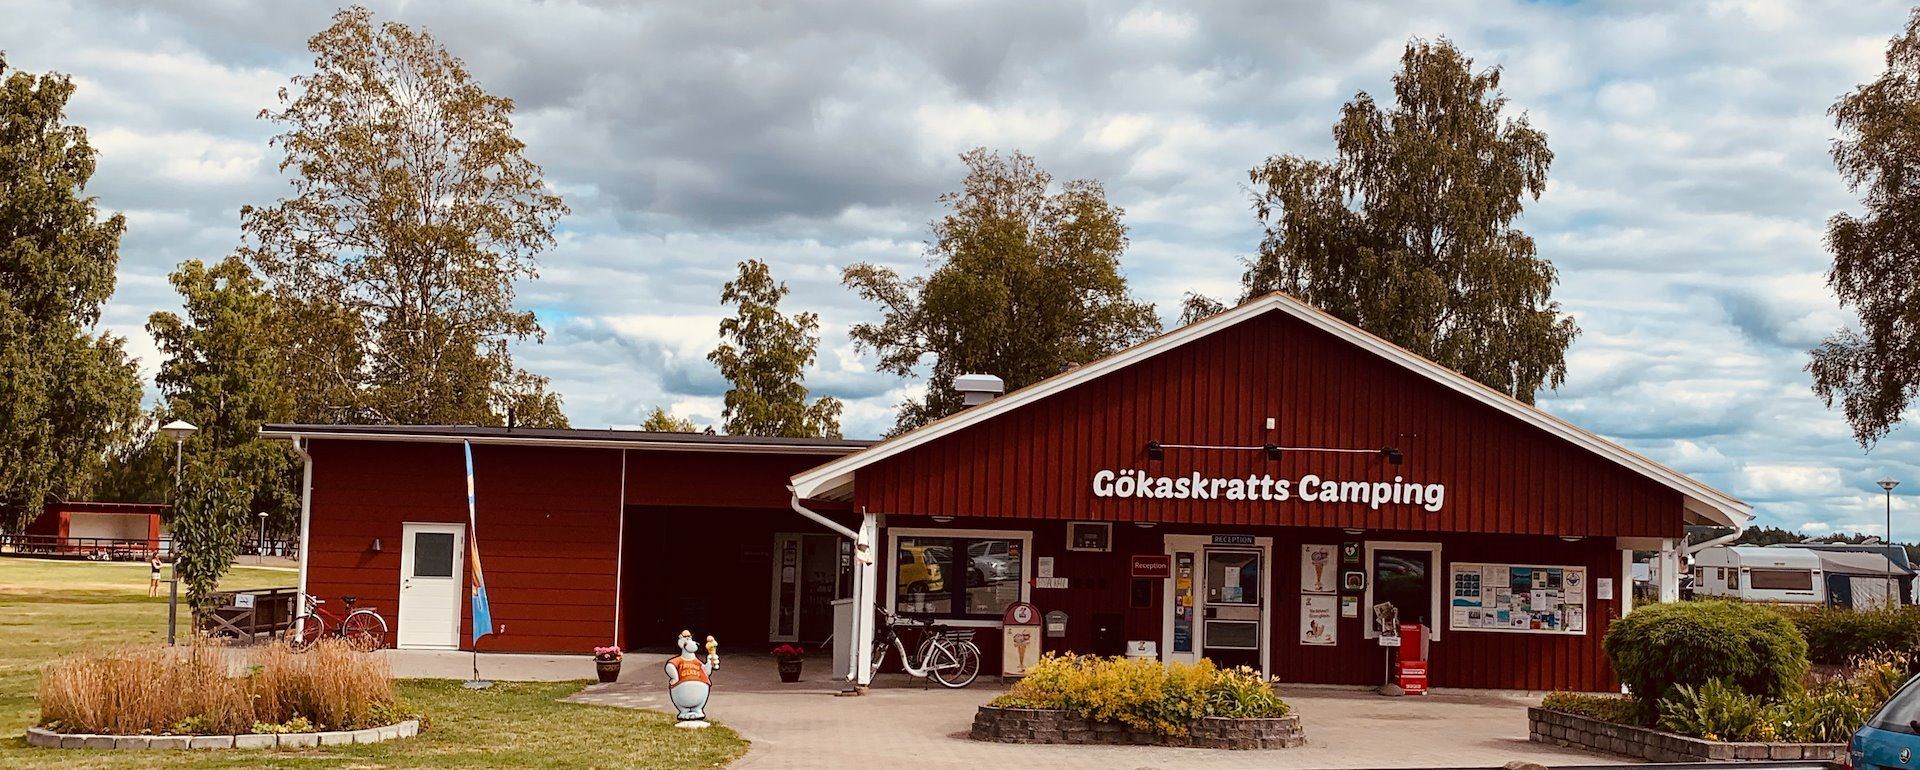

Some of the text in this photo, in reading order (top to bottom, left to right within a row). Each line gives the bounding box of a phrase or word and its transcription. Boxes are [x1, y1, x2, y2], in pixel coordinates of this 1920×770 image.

[1092, 468, 1445, 512] Gökaskratts Camping
[1214, 536, 1252, 544] RECEPTION
[1134, 561, 1167, 570] Reception
